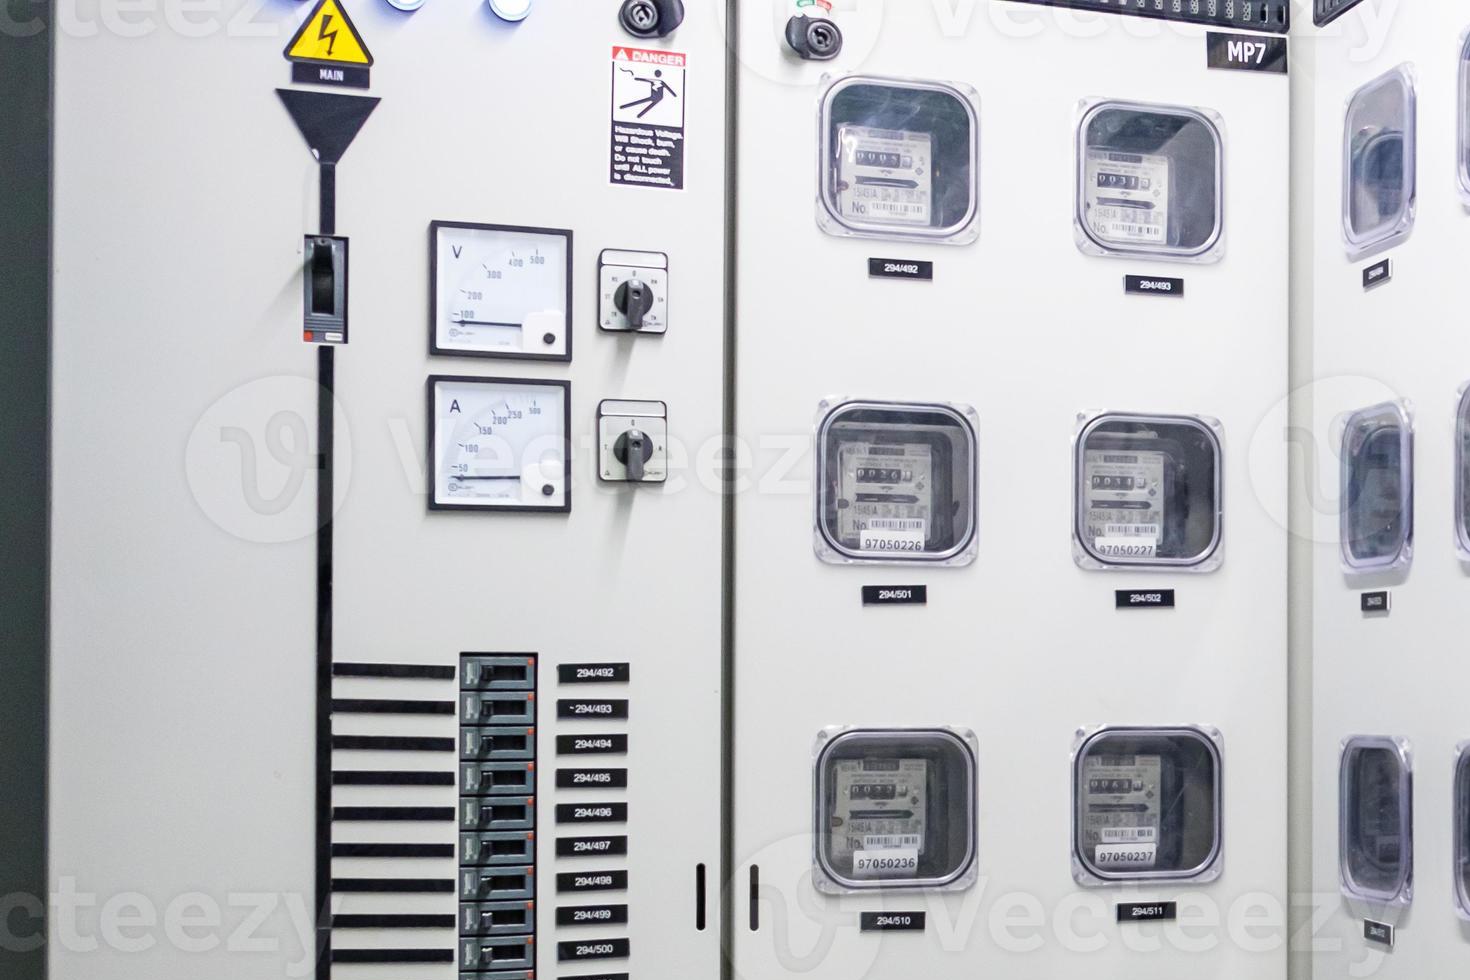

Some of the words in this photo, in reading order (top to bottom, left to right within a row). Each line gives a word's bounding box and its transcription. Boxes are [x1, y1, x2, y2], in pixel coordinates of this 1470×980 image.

[1227, 41, 1266, 64] MP7
[632, 50, 684, 66] DANGER
[320, 69, 344, 81] MAIN
[615, 153, 626, 161] Do
[632, 165, 648, 173] ALL
[452, 245, 462, 259] V
[509, 258, 523, 267] 400
[530, 256, 544, 265] 500
[884, 263, 919, 274] 294/492
[487, 270, 502, 279] 300
[1139, 280, 1172, 291] 294/493
[467, 292, 482, 300] 200
[460, 310, 474, 319] 100
[449, 400, 461, 413] A
[529, 407, 541, 415] 500
[508, 410, 522, 419] 250
[492, 416, 507, 425] 200
[479, 427, 492, 435] 150
[465, 444, 478, 453] 100
[458, 464, 468, 473] 50
[865, 538, 922, 551] 97050226
[1099, 545, 1154, 556] 97050227
[878, 589, 912, 599] 294/501
[1129, 593, 1162, 603] 294/502
[576, 667, 614, 678] 294/492
[575, 704, 613, 714] 294/493
[574, 739, 612, 749] 294/494
[573, 772, 611, 783] 294/495
[574, 807, 612, 818] 294/496
[573, 840, 611, 852] 294/497
[1099, 851, 1154, 862] 97050237
[858, 857, 916, 869] 97050236
[574, 875, 613, 887] 294/498
[573, 909, 612, 921] 294/499
[1131, 906, 1163, 916] 294/511
[876, 916, 911, 926] 294/510
[576, 943, 614, 956] 294/500
